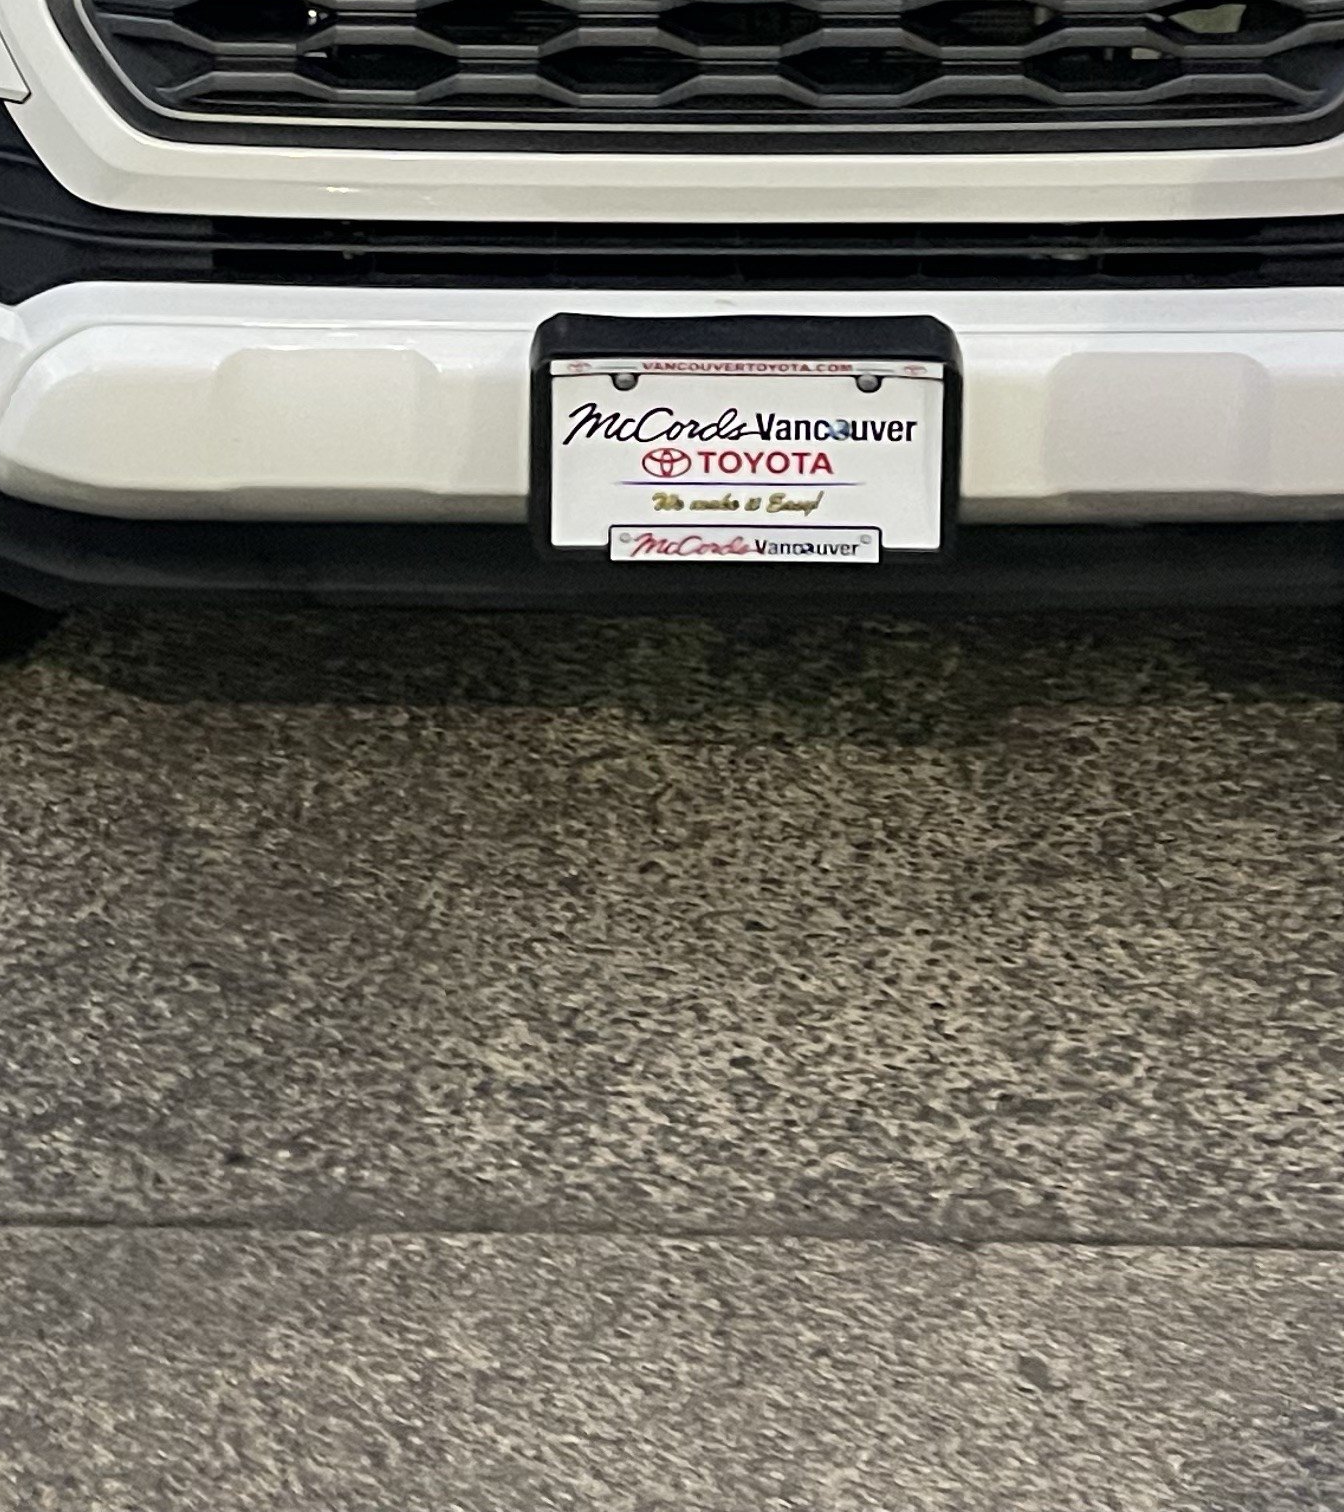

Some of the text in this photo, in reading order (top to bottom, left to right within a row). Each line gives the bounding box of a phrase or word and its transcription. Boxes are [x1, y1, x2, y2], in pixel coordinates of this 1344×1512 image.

[562, 401, 918, 446] McCords Vancouver
[697, 451, 834, 475] TOYOTA
